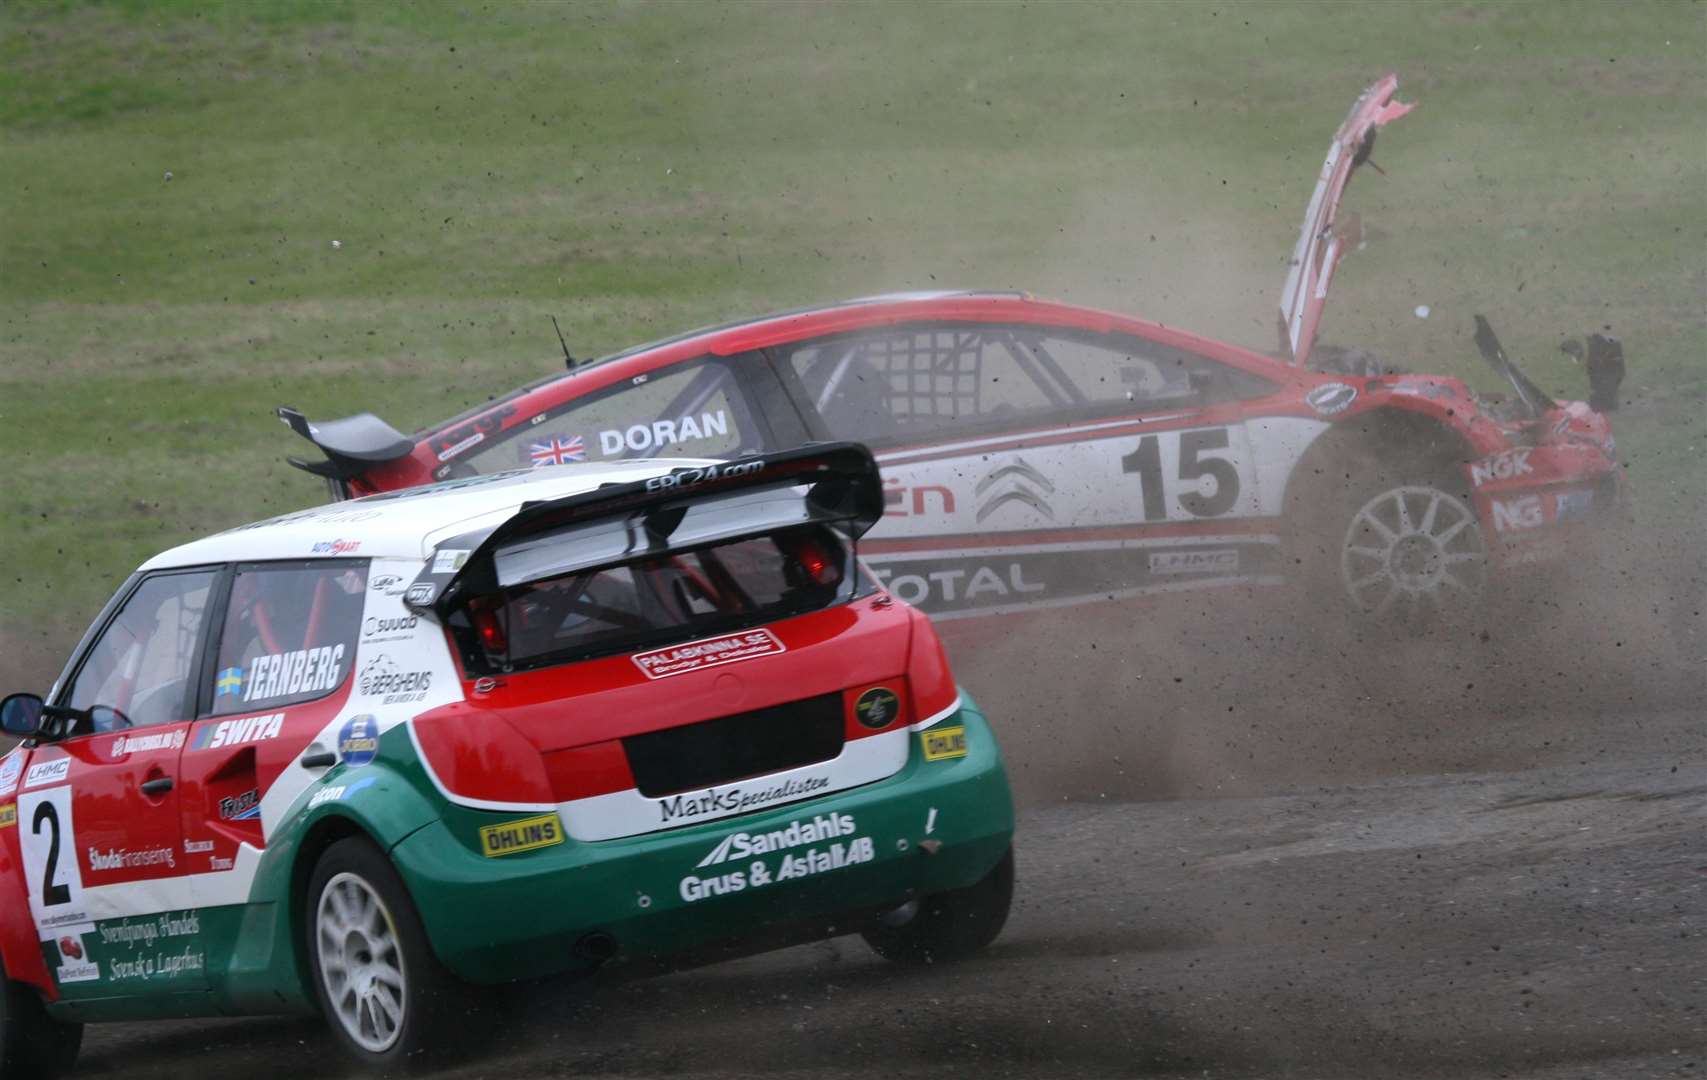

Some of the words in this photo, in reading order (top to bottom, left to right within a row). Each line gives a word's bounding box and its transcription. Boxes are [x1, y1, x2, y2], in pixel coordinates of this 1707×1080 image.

[600, 410, 728, 456] DORAN
[1122, 428, 1240, 522] 15
[1471, 447, 1534, 487] NGK
[244, 643, 345, 702] JERNBERG
[210, 713, 286, 748] SWITA
[29, 761, 68, 780] LHMC
[33, 801, 71, 906] 2
[487, 822, 556, 852] ÖHLINS
[728, 812, 856, 861] Sandahls
[680, 871, 748, 902] Grus
[749, 860, 773, 888] &
